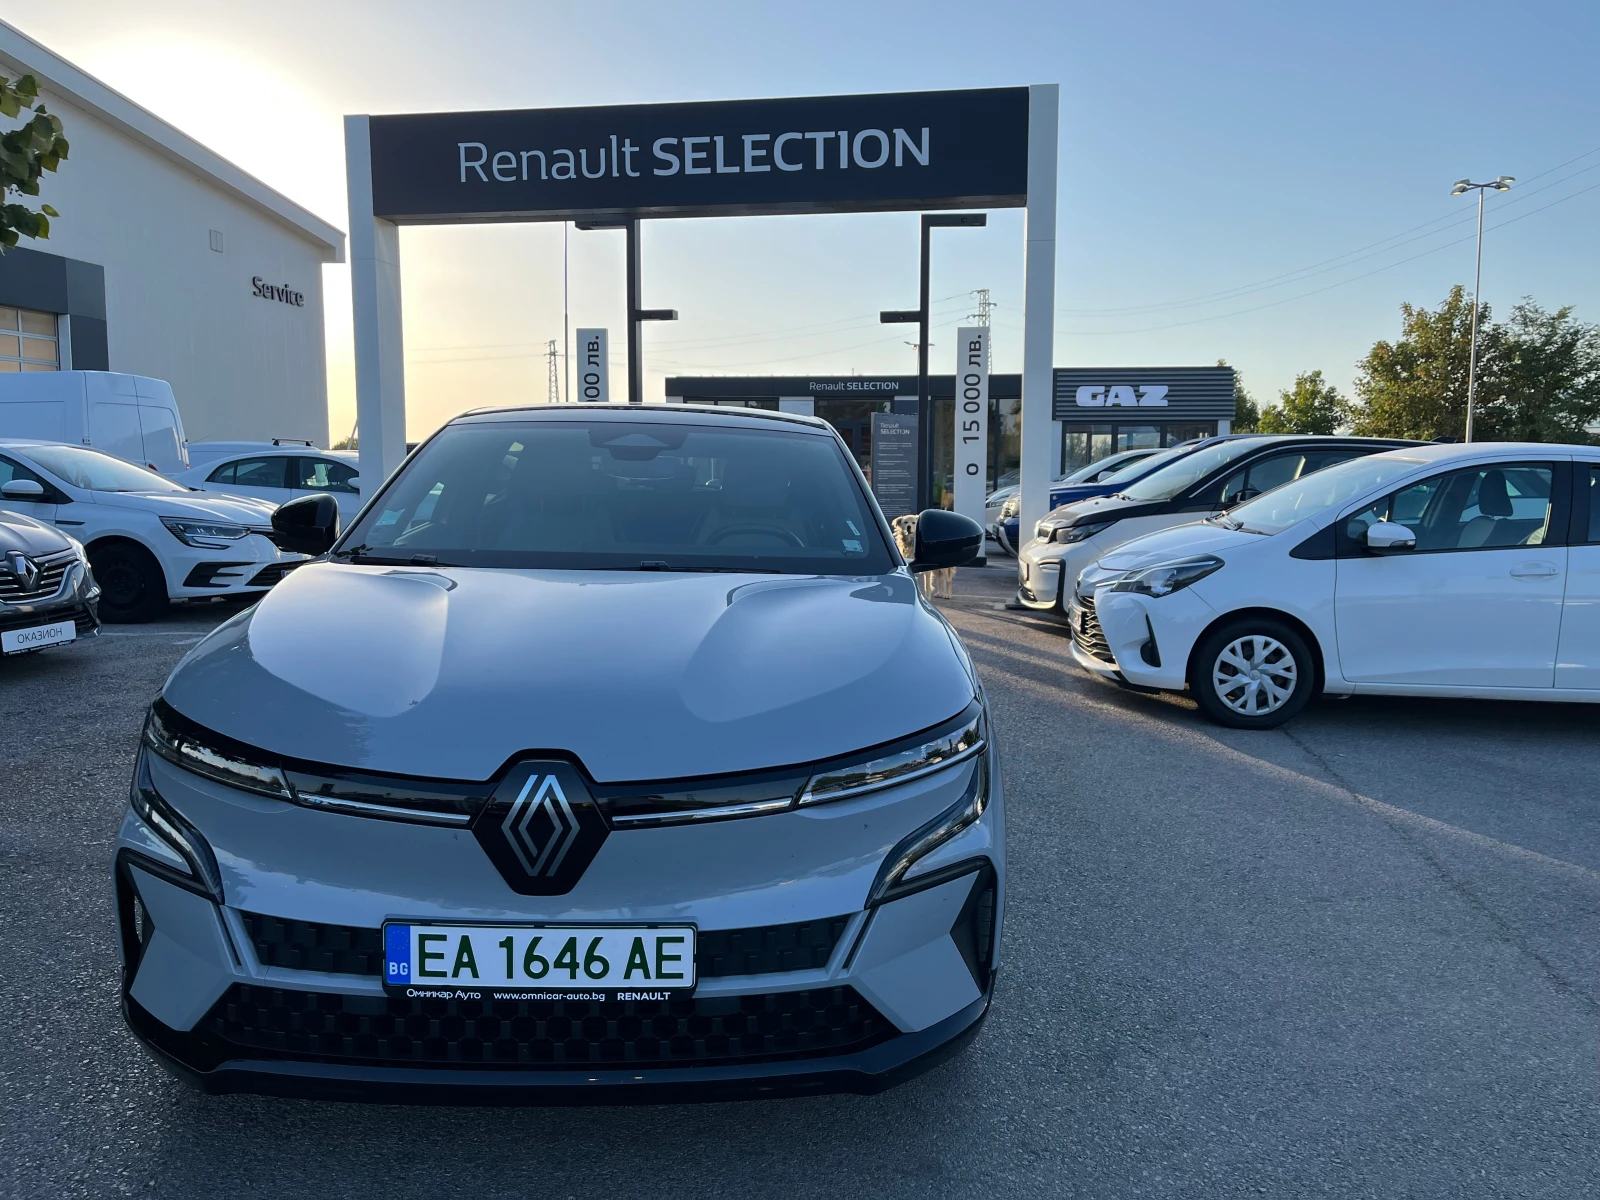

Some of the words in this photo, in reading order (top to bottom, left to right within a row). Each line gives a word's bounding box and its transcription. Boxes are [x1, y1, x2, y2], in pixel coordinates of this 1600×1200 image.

[457, 134, 640, 183] Renault
[652, 126, 931, 178] SELECTION
[252, 276, 305, 308] Service
[583, 372, 601, 402] 00
[809, 381, 845, 391] Renault
[846, 381, 899, 390] SELECTION
[1075, 385, 1169, 407] GAZ
[17, 626, 63, 644] ОКАЗИОН
[418, 933, 480, 979] EA
[498, 935, 610, 980] 1646
[623, 936, 685, 980] AE
[389, 961, 409, 976] BG
[493, 991, 606, 1002] www.omnicar-auto.bg
[617, 992, 671, 1001] RENAULT
